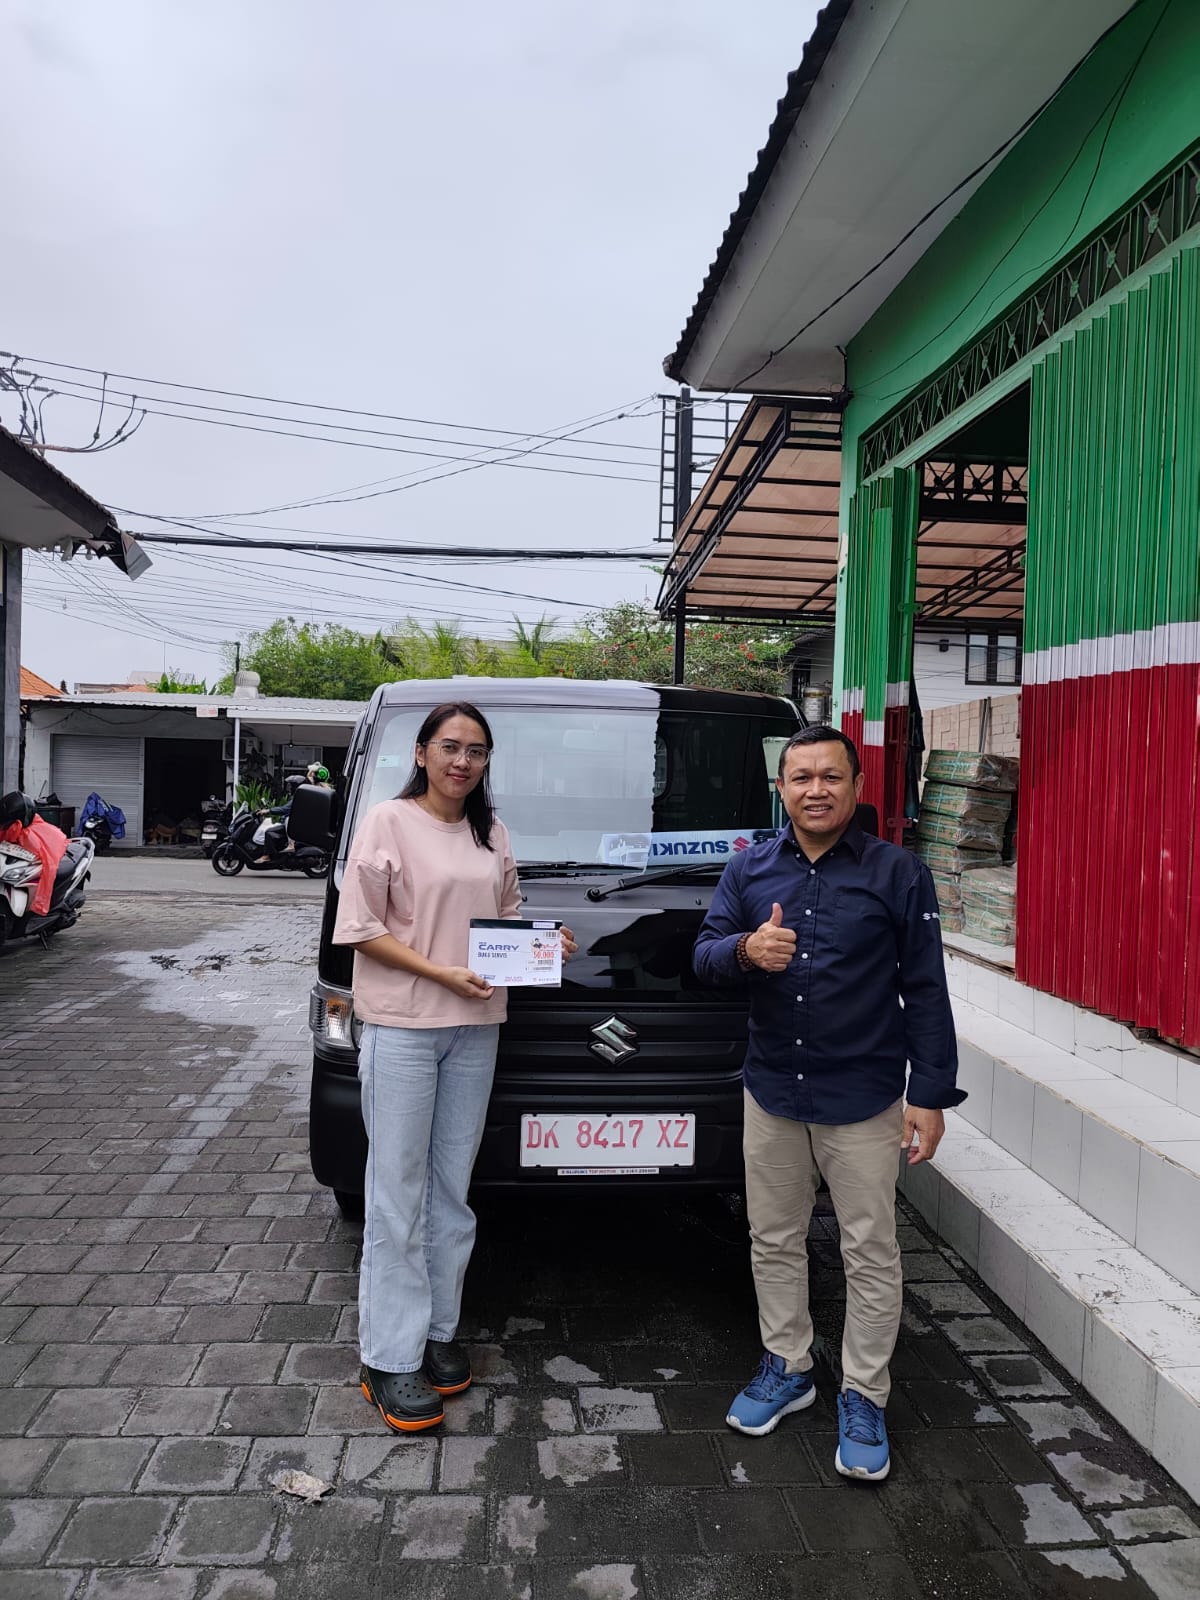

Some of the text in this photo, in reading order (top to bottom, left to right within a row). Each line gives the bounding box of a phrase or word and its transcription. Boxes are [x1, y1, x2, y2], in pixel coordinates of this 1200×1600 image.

[652, 840, 729, 856] SUZUKI
[526, 1119, 689, 1149] DK 8417 XZ
